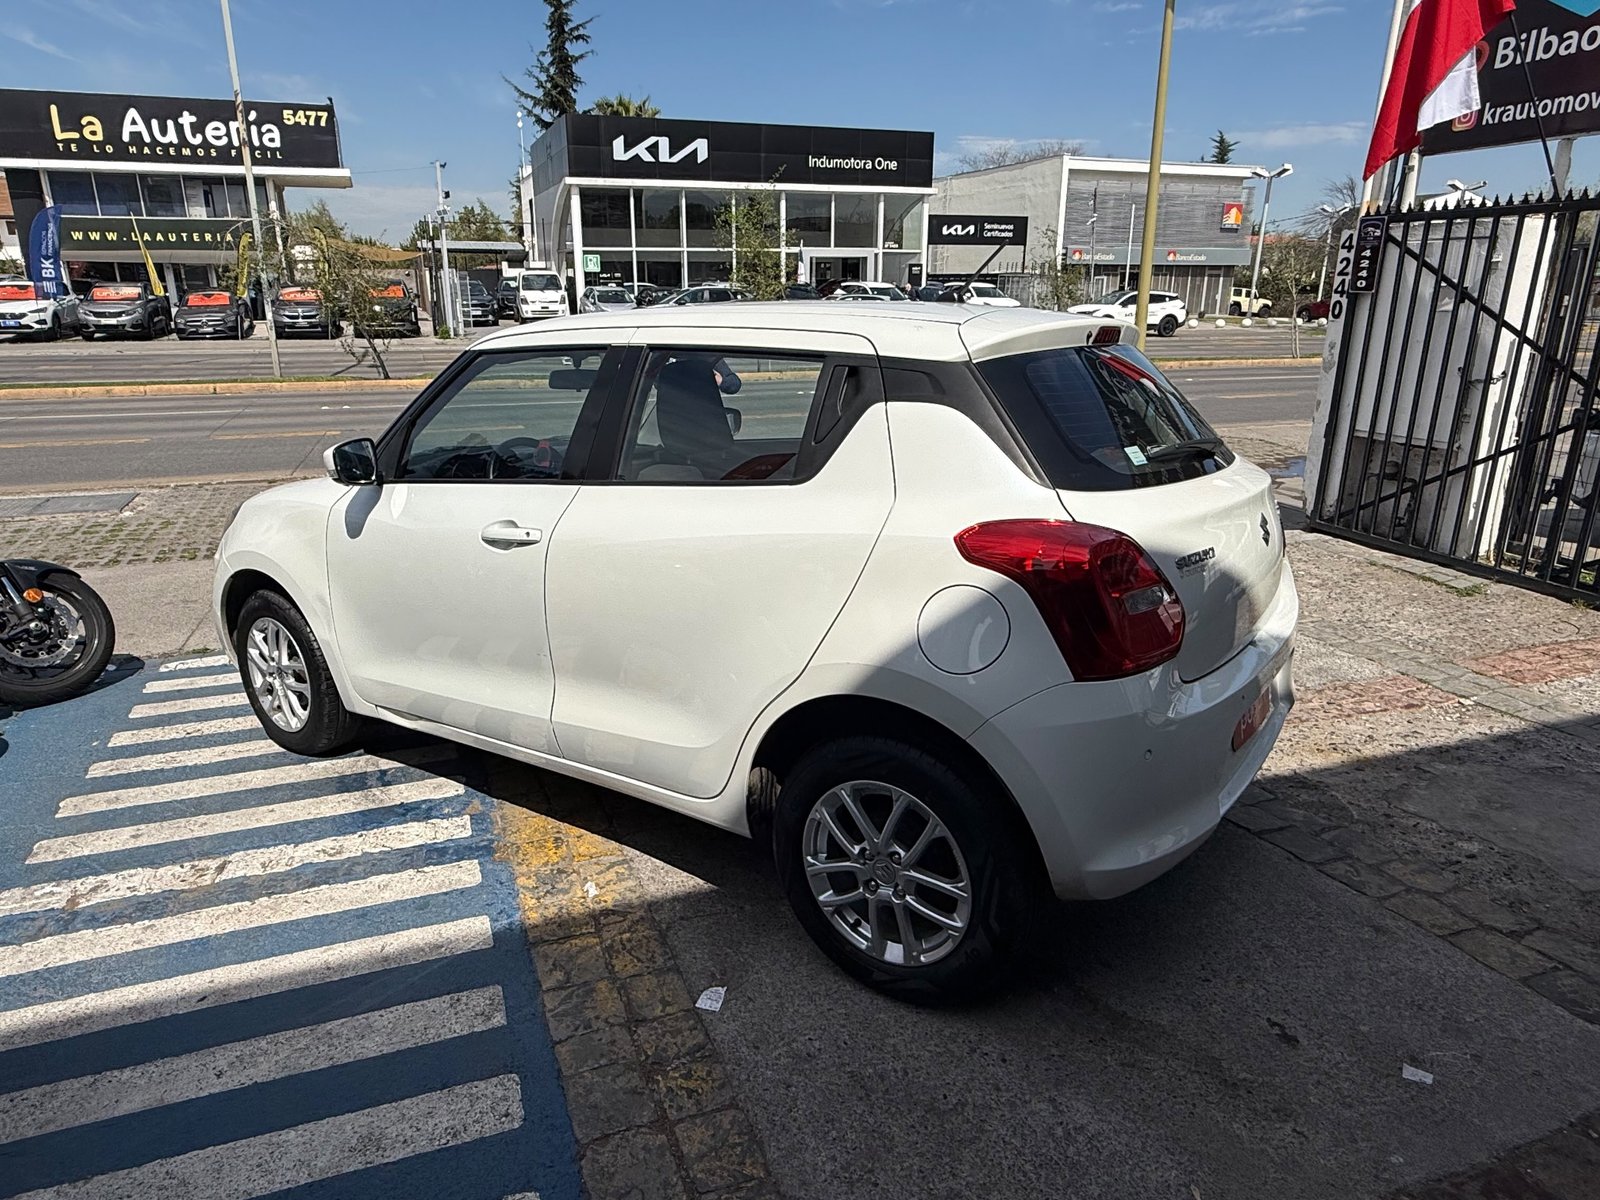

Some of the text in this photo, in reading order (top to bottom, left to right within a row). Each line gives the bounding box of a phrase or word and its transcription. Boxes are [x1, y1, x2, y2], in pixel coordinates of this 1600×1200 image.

[1493, 25, 1600, 69] Bilbao
[50, 104, 282, 149] La Autería
[282, 109, 328, 127] 5477
[56, 142, 283, 159] TE LO HACEMOS FCIL
[612, 134, 709, 164] KIA
[808, 155, 898, 171] Indumotora One
[941, 224, 976, 236] KIA
[40, 257, 56, 278] BK
[1331, 233, 1354, 320] 4240
[1356, 249, 1372, 288] 4240
[1175, 546, 1216, 570] SUZUKI
